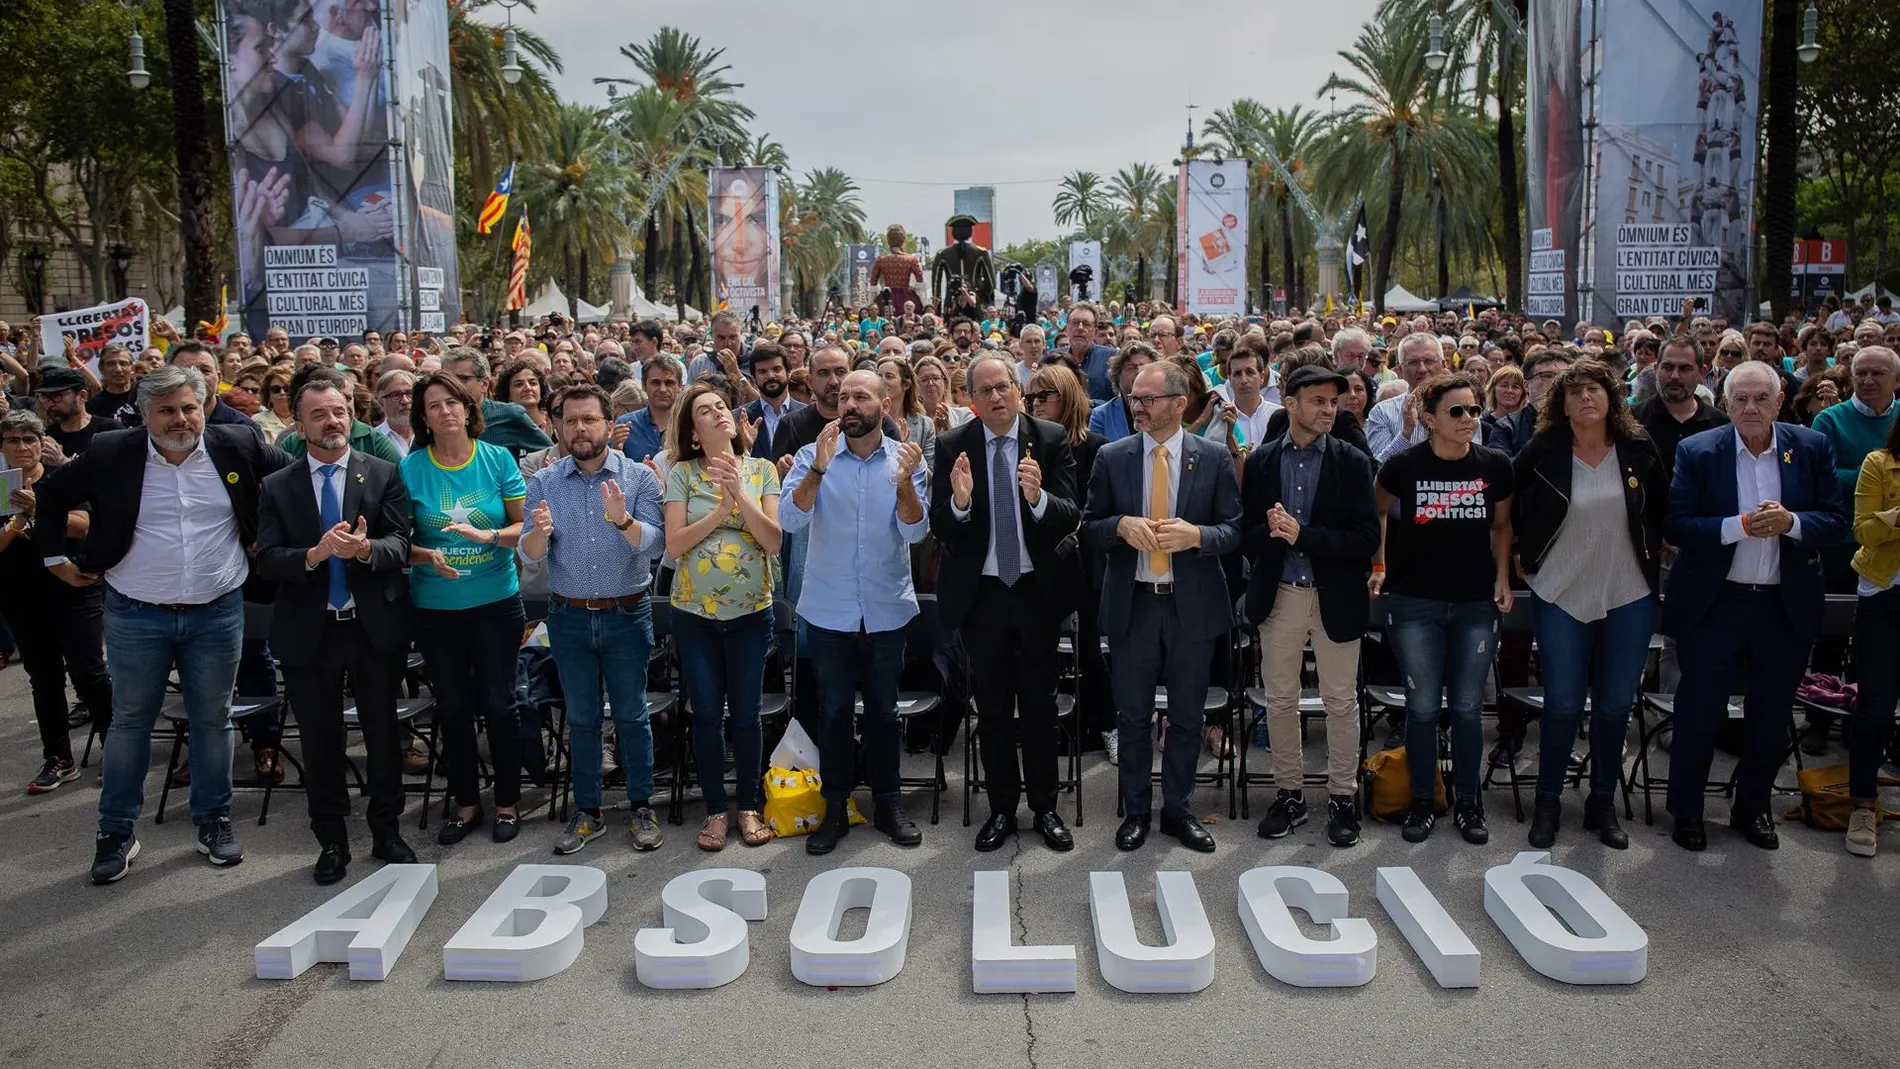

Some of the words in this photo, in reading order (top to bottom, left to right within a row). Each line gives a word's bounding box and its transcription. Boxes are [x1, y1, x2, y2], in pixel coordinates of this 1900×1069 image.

[1618, 224, 1669, 243] ÒMNIUM
[1673, 223, 1689, 243] ÉS
[266, 246, 316, 265] ÒMNIUM
[319, 245, 334, 264] ÉS
[1617, 250, 1675, 267] L'ENTITAT
[1678, 247, 1719, 266] CÍVICA
[1821, 242, 1833, 262] B
[267, 272, 324, 288] L'ENTITAT
[328, 269, 368, 287] CÍVICA
[1617, 274, 1621, 290] I
[1624, 274, 1684, 290] CULTURAL
[1686, 270, 1713, 290] MÉS
[268, 296, 273, 312] I
[276, 296, 336, 312] CULTURAL
[339, 292, 365, 311] MÉS
[1617, 298, 1648, 314] GRAN
[57, 305, 139, 327] LLIBERTAT
[307, 318, 366, 334] D'EUROPA
[61, 320, 143, 344] PRESOS
[1416, 480, 1484, 491] LLIBERTAT
[1416, 492, 1485, 506] PRESOS
[1416, 506, 1487, 519] POLÍTICS!
[255, 851, 1648, 994] ABSOLUCIÓ
